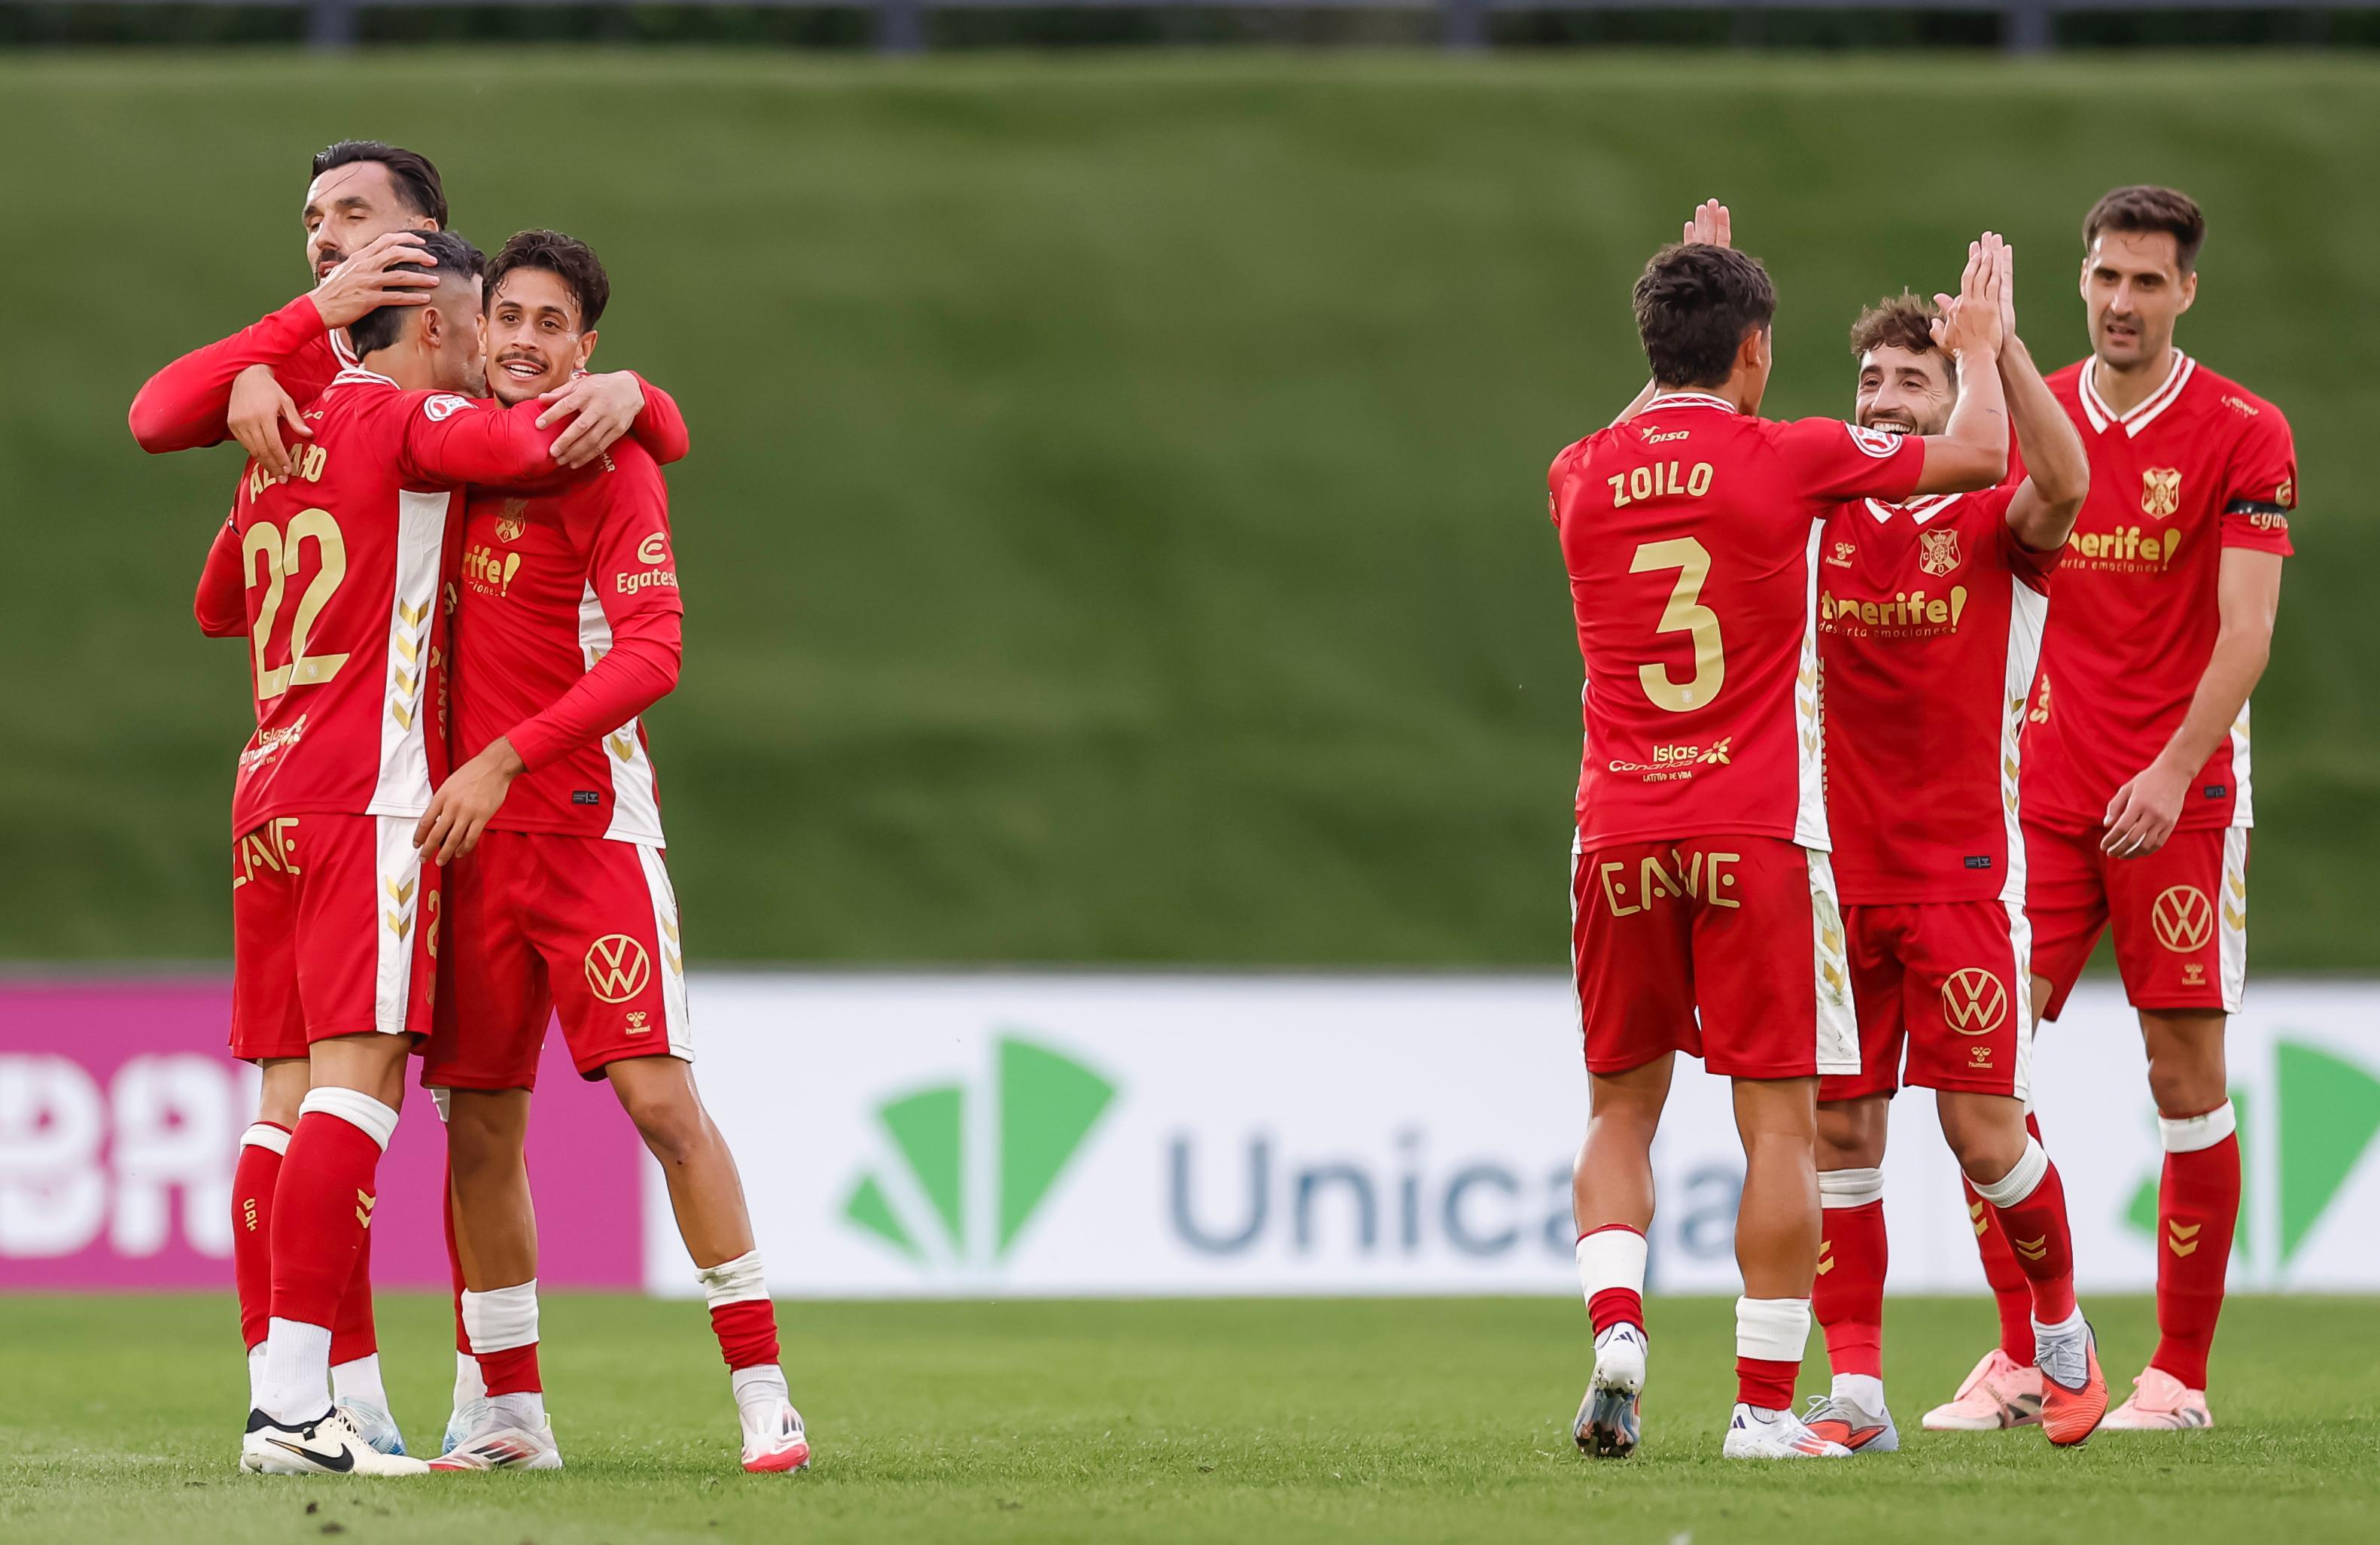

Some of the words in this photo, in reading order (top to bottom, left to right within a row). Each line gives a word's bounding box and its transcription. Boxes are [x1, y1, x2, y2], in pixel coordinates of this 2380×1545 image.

[1607, 461, 1714, 509] ZOILO
[242, 508, 350, 701] 22
[1628, 537, 1725, 713] 3
[1608, 759, 1694, 772] Canarias
[1653, 744, 1698, 763] Islas
[1678, 770, 1692, 780] VIDA
[2152, 884, 2214, 953] VW
[584, 933, 651, 1002] VW
[1942, 967, 2007, 1036] VW
